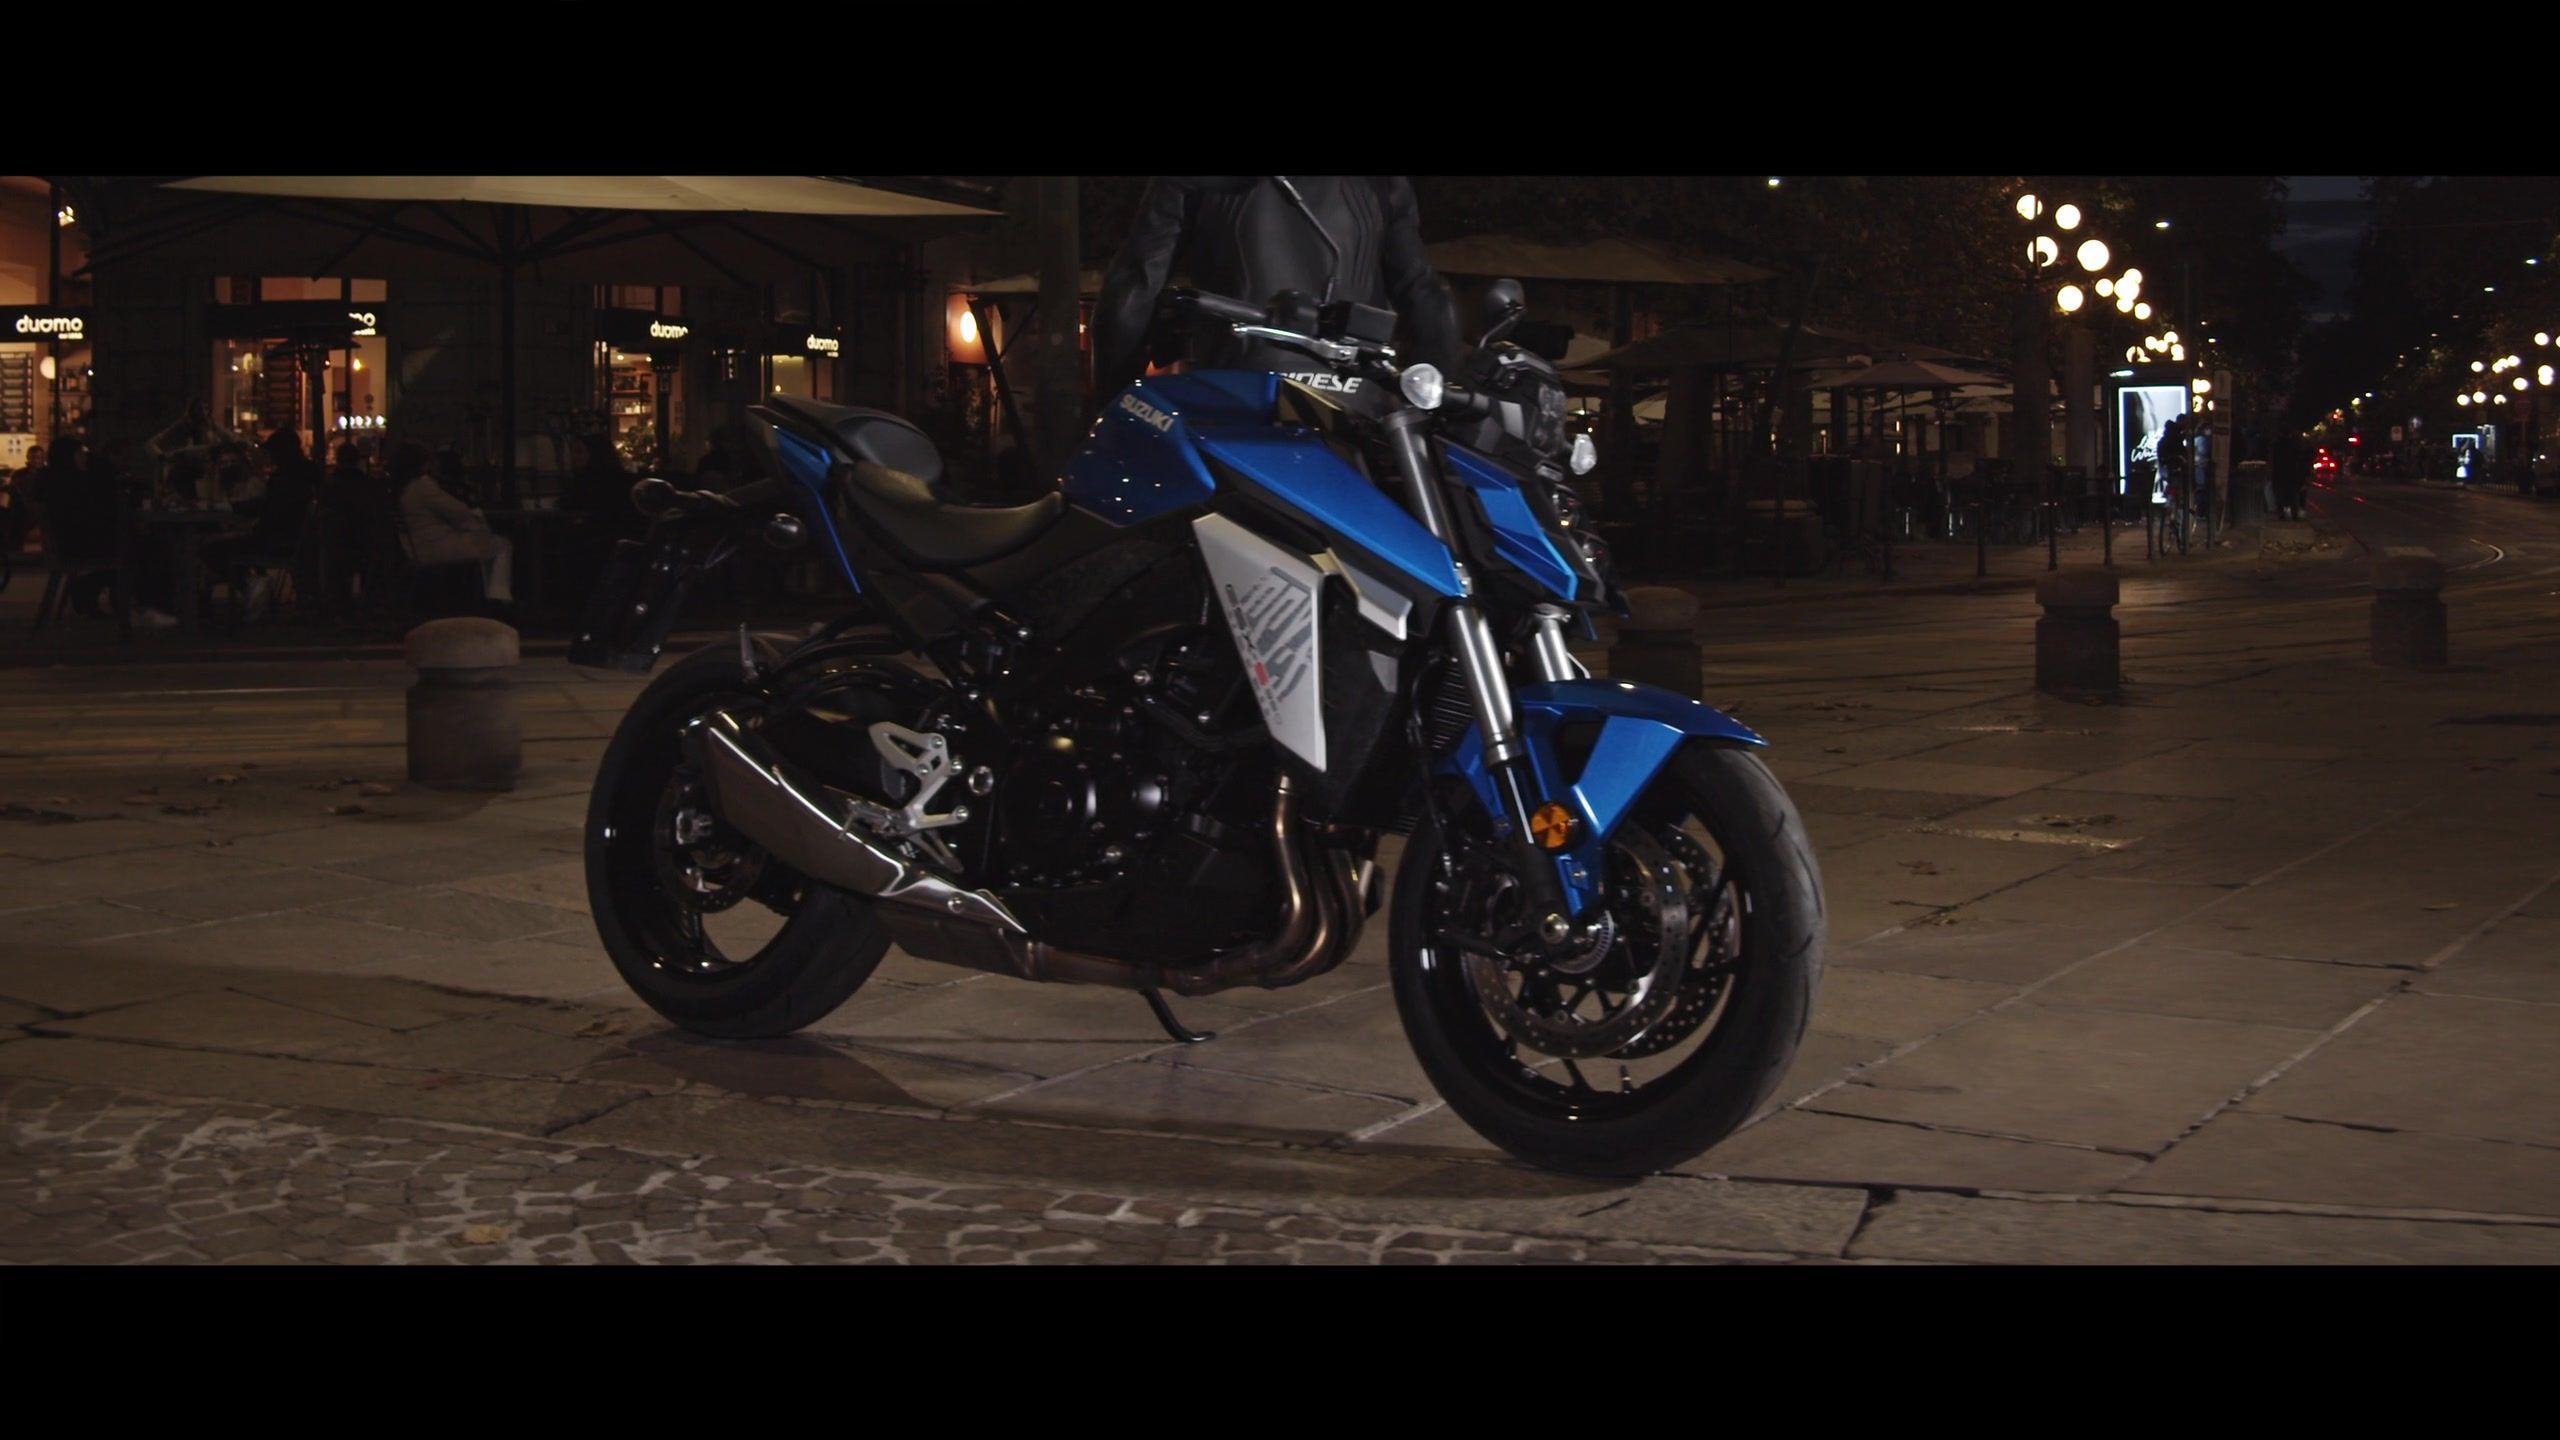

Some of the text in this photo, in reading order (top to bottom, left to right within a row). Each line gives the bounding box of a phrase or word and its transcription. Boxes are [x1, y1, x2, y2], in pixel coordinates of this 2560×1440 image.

[16, 314, 83, 333] duomo
[806, 333, 839, 351] duomo
[1119, 393, 1175, 433] SUZUKI
